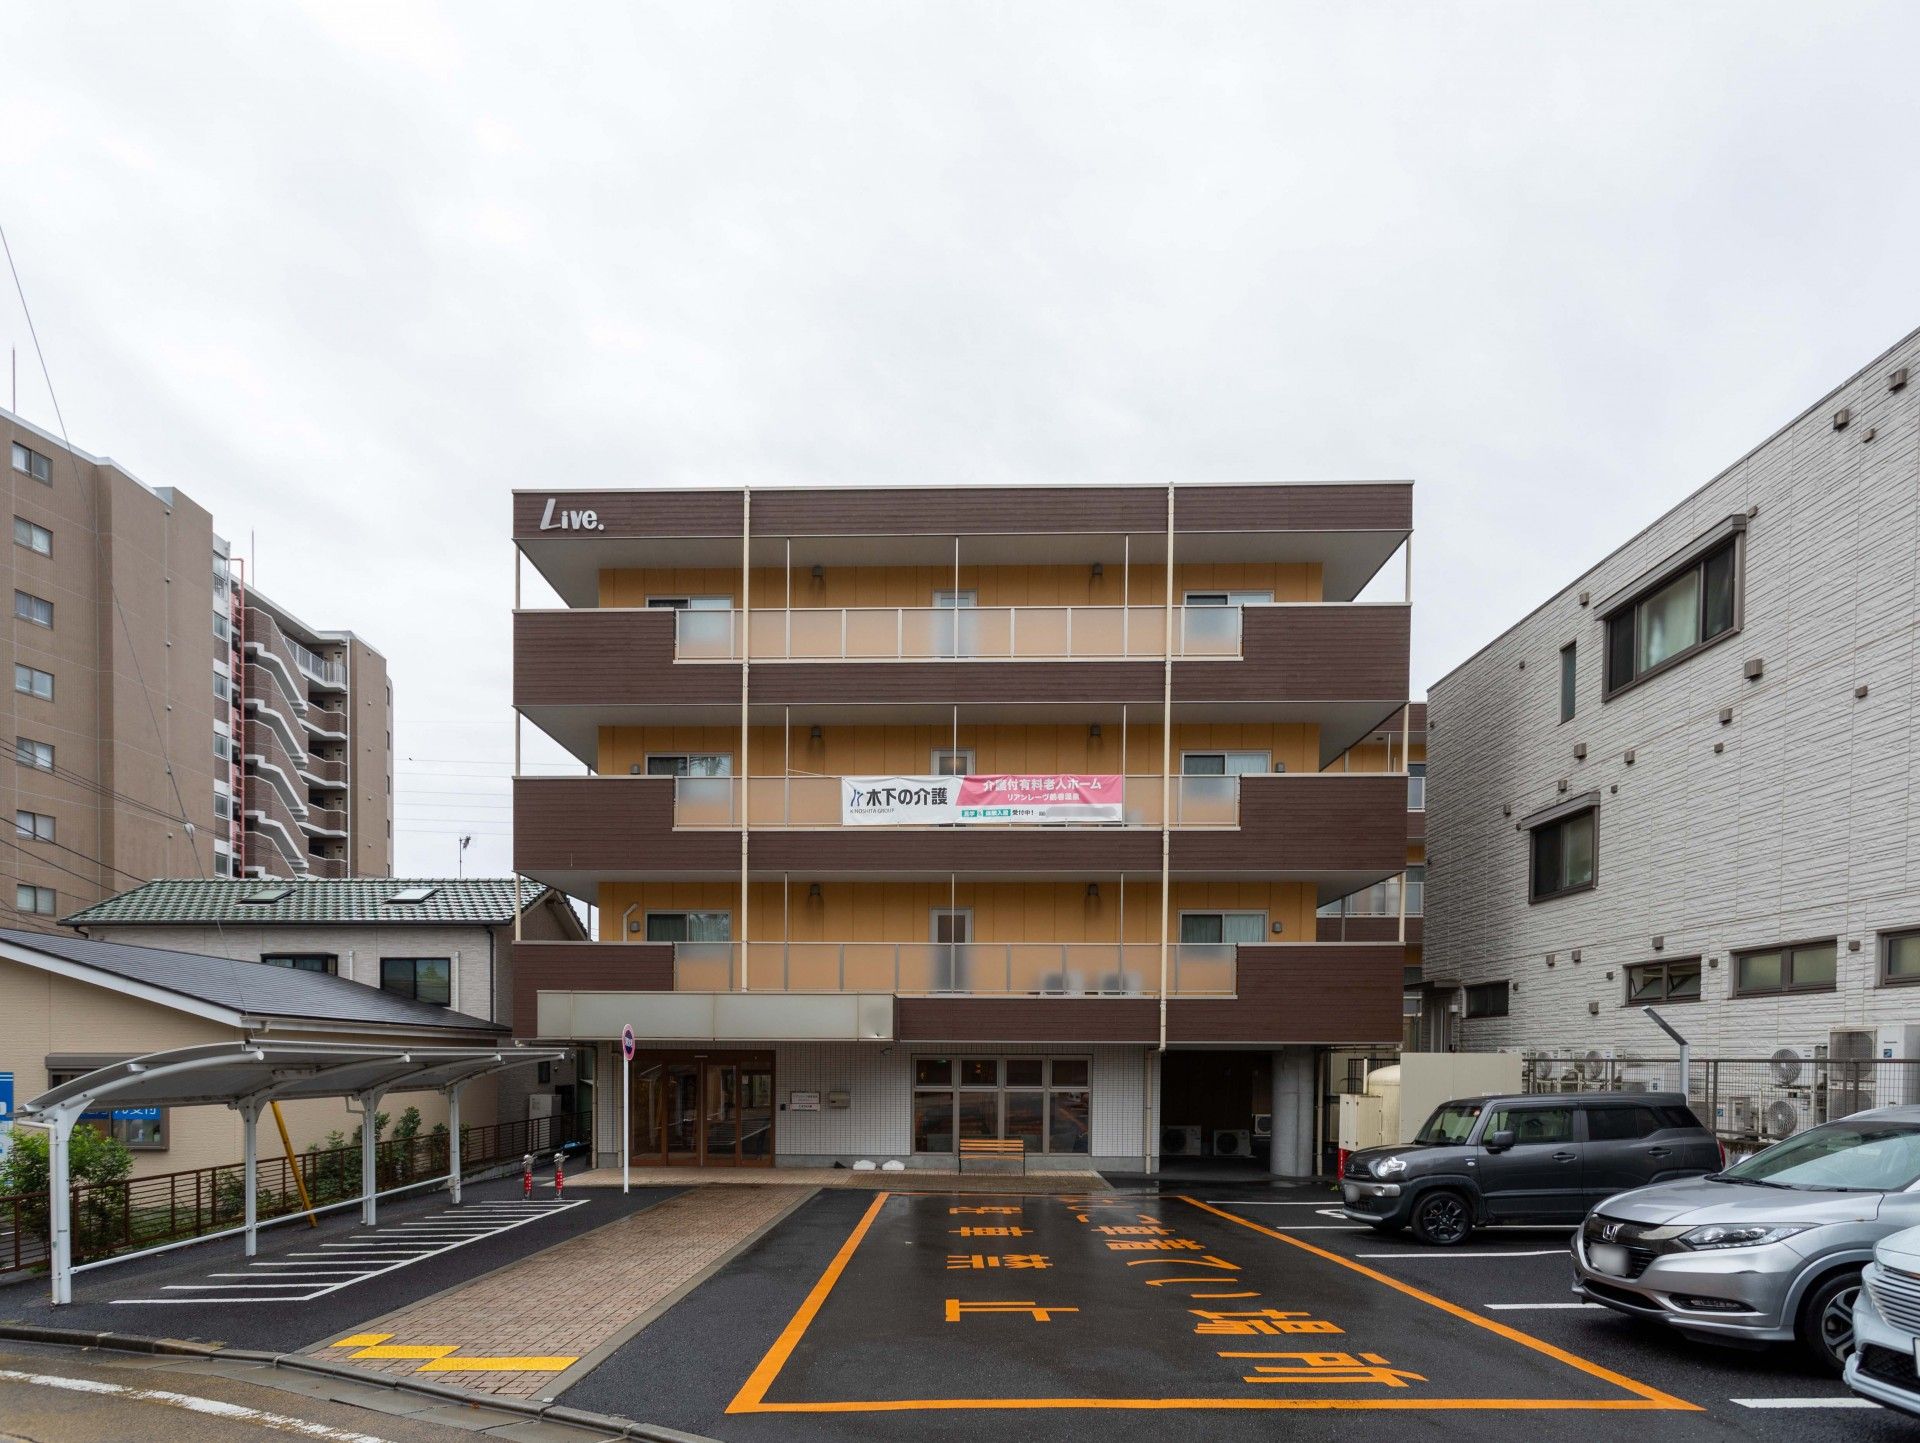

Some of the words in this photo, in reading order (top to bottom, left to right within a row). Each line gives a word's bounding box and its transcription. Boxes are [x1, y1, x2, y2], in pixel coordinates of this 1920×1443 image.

[540, 498, 605, 531] Live.
[866, 787, 948, 807] 木下の介護
[983, 778, 1102, 792] 介護付有料老人ホーム
[945, 1206, 1079, 1322] 駐車禁止
